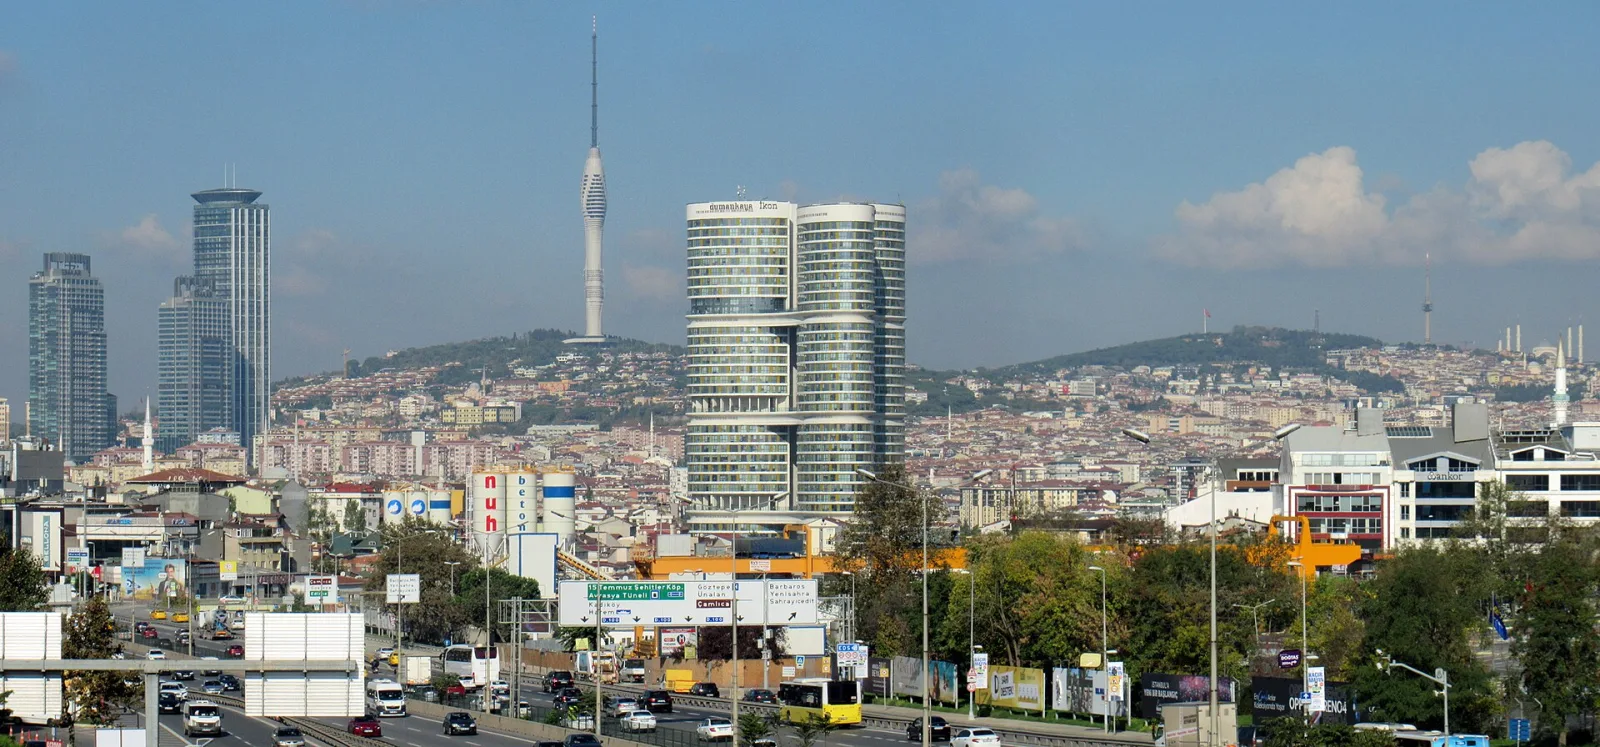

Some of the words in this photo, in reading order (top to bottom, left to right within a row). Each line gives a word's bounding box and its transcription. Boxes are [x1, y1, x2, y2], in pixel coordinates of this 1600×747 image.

[709, 202, 753, 211] dumankaya
[485, 475, 497, 531] nuh
[666, 584, 684, 592] Köp.
[698, 583, 731, 592] Göztepe
